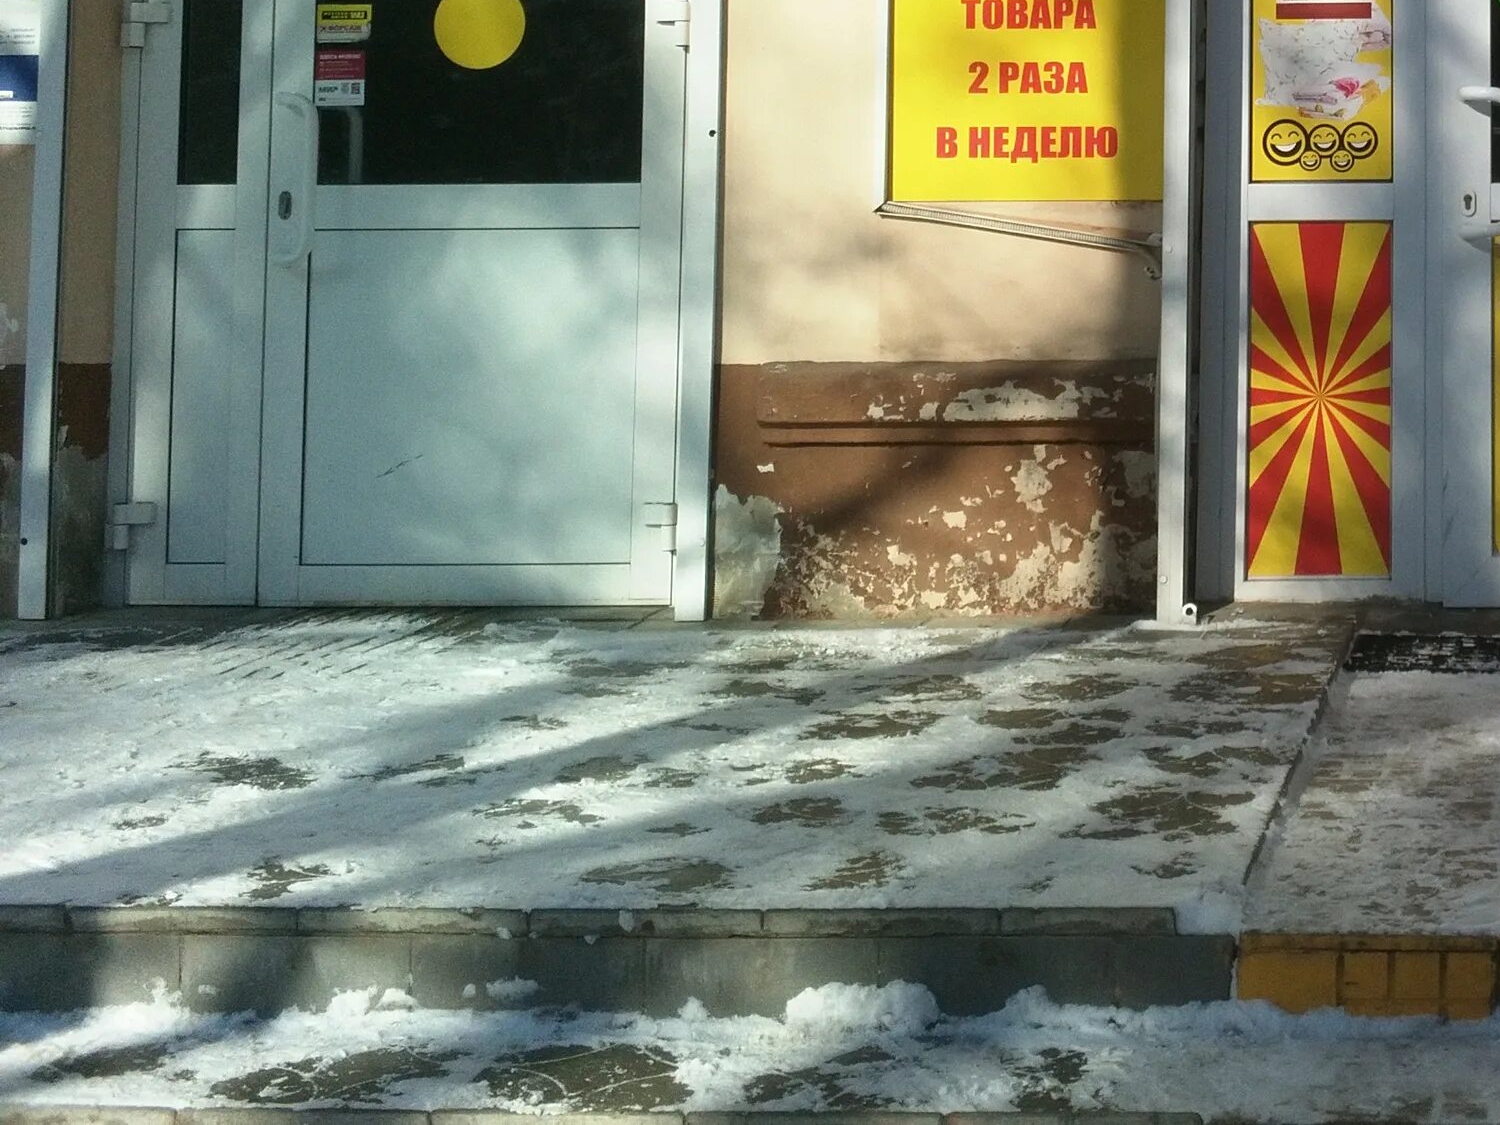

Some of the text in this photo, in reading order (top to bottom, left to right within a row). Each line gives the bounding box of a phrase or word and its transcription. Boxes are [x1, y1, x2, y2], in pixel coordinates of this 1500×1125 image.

[968, 61, 1089, 94] 2 РАЗА
[935, 126, 1120, 164] В НЕДЕЛЮ
